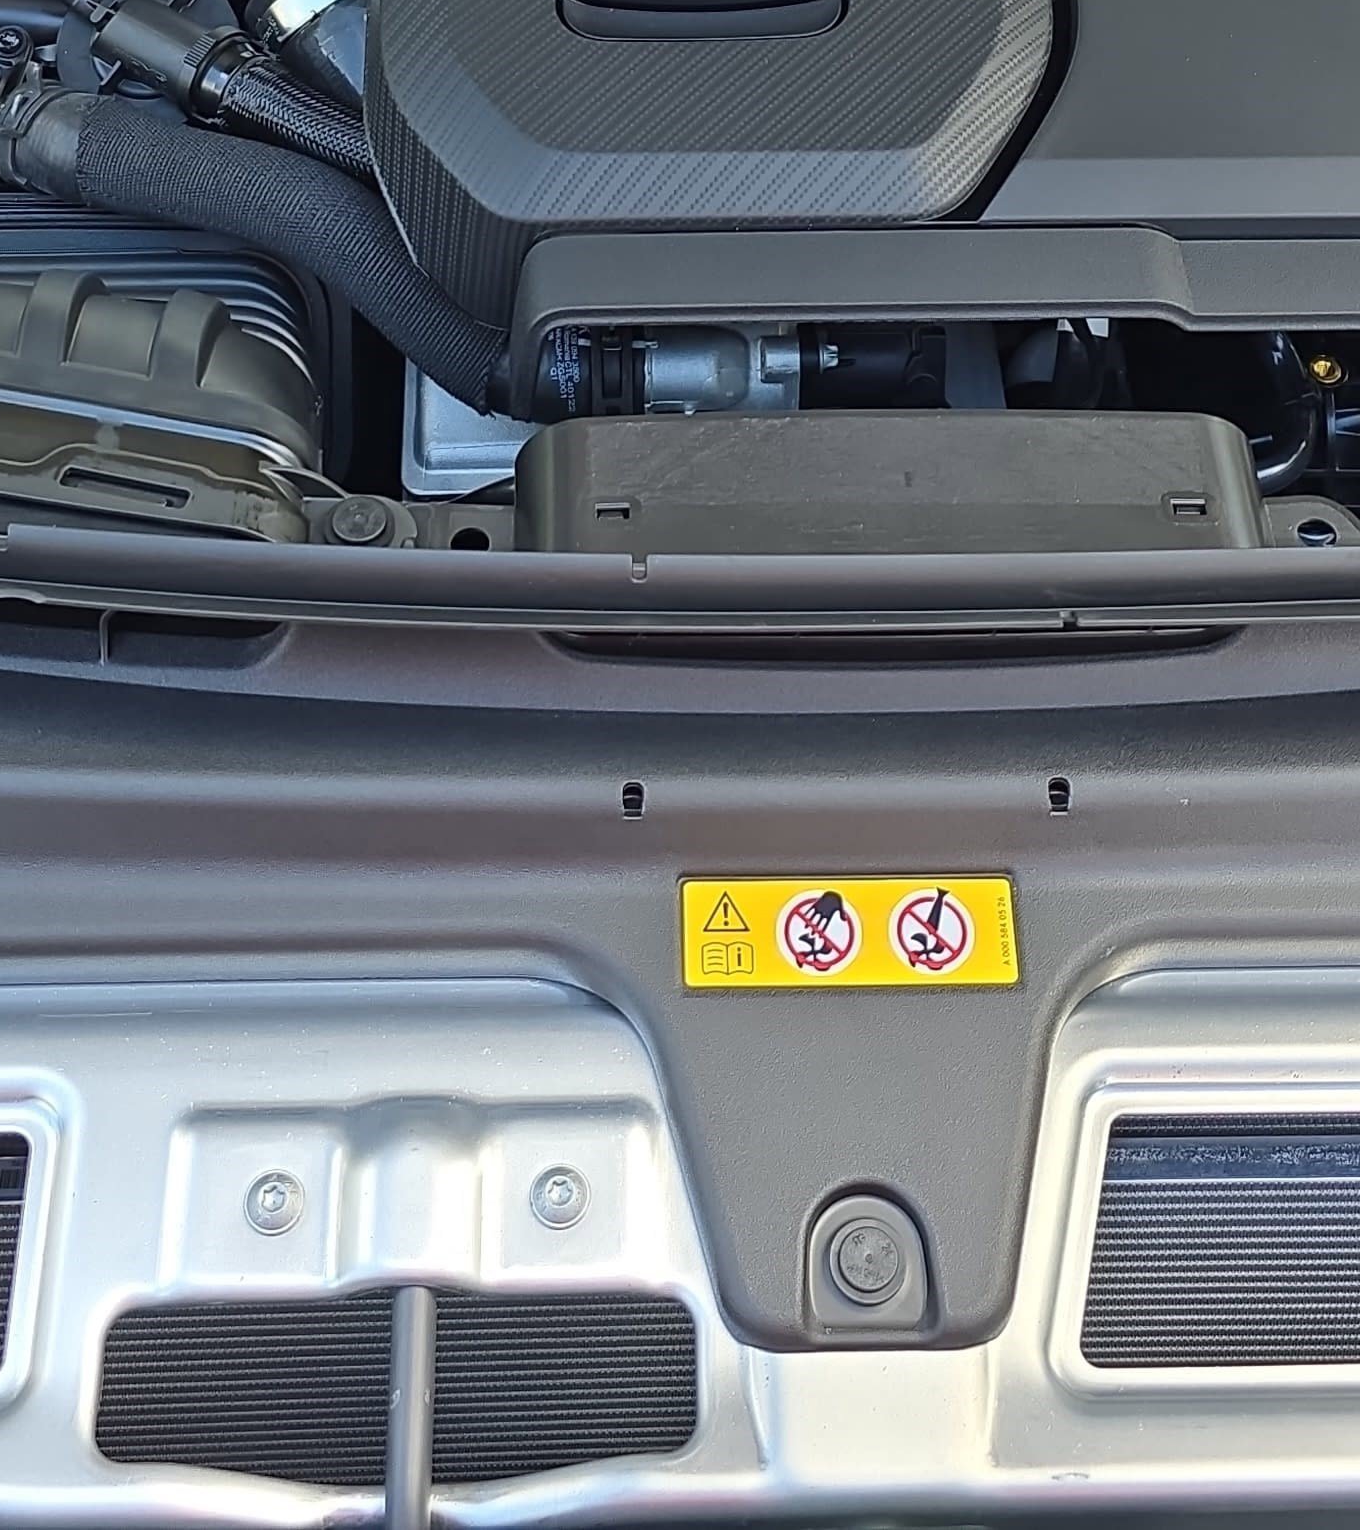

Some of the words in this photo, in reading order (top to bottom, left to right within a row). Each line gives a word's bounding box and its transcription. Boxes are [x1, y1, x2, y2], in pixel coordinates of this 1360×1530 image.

[998, 896, 1006, 908] 26
[998, 908, 1008, 920] 05
[1000, 940, 1011, 958] 000
